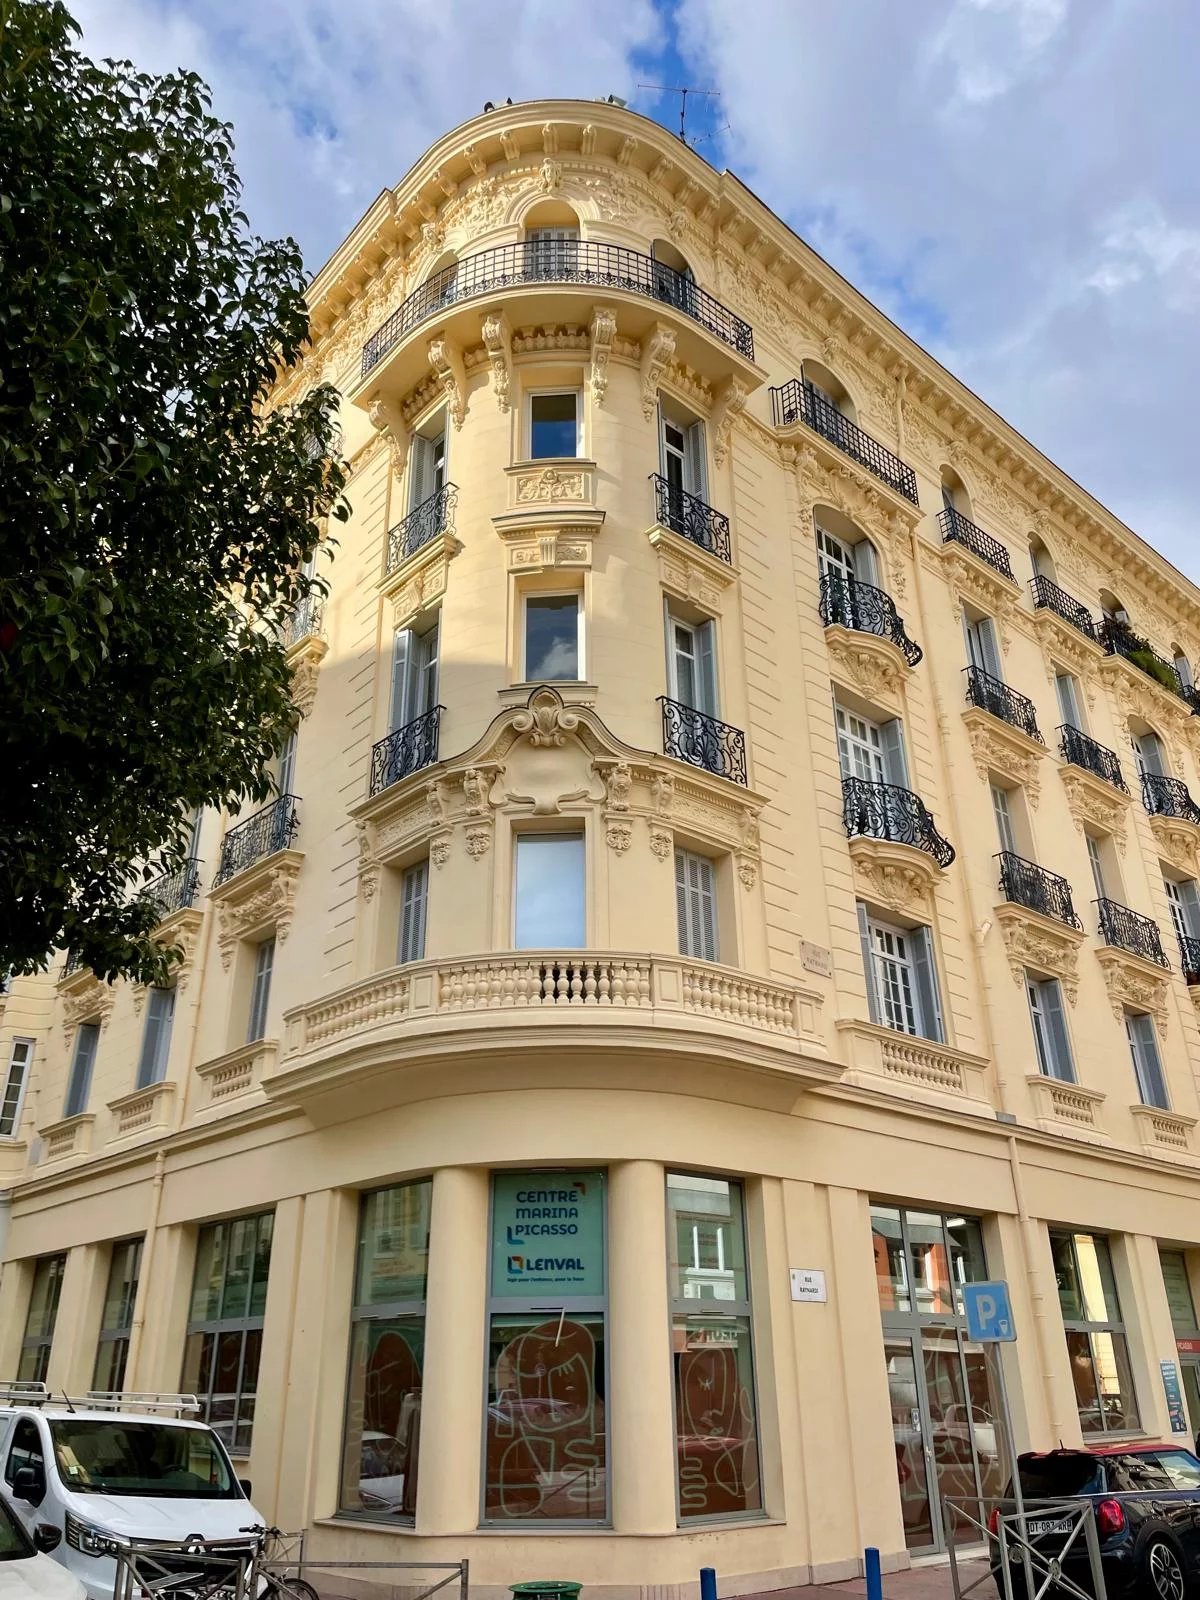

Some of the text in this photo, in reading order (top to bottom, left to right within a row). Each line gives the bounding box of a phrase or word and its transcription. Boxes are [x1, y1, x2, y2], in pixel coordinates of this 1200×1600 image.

[516, 1190, 578, 1203] CENTRE
[515, 1207, 578, 1219] MARINA
[515, 1224, 578, 1236] PICASSO
[526, 1258, 585, 1271] LENVAL
[976, 1294, 997, 1330] P
